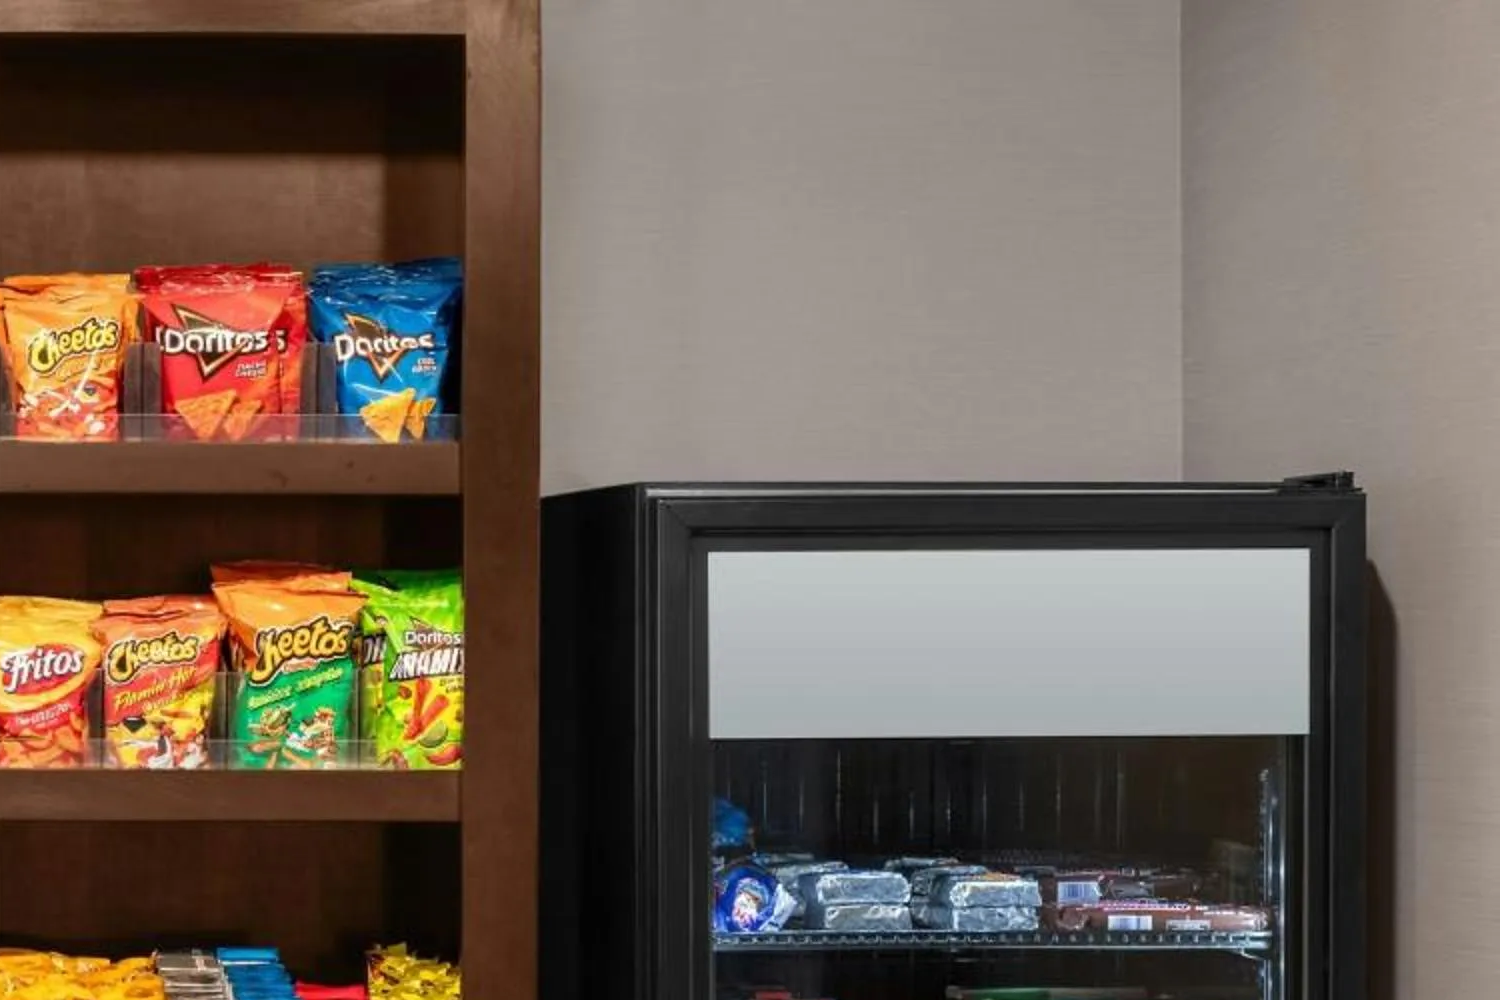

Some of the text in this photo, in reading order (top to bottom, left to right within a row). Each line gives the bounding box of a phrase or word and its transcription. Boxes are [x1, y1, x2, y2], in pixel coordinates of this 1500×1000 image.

[28, 317, 118, 373] Cheetos
[164, 329, 269, 354] Doritos
[335, 333, 435, 360] Doritos
[404, 631, 462, 645] Doritos
[0, 649, 84, 693] Fritos
[108, 631, 199, 683] Cheetos
